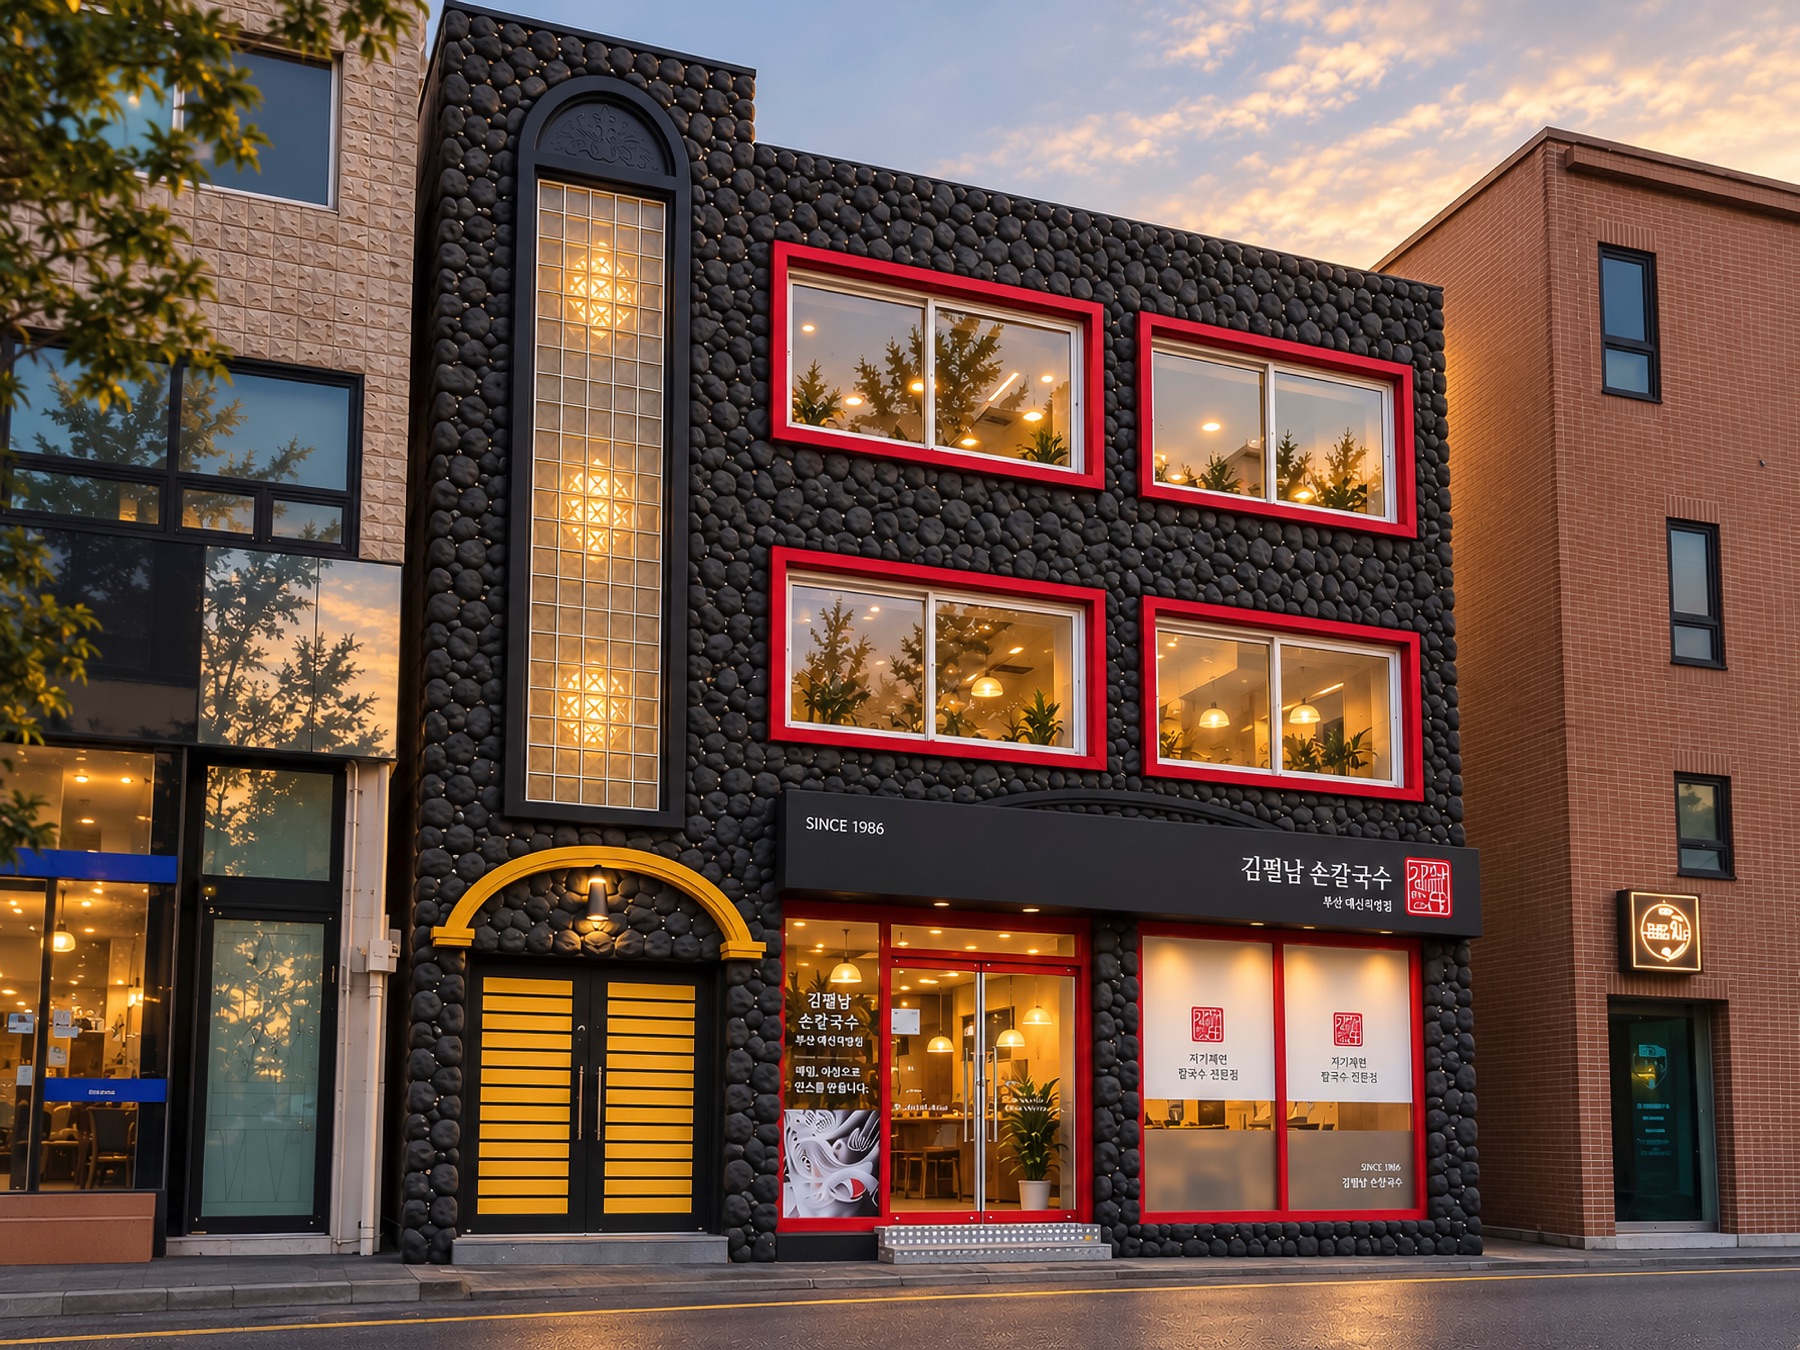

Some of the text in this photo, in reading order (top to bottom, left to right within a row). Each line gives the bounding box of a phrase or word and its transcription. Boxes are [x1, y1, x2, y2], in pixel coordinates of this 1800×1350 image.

[805, 816, 885, 835] SINCE 1986
[1240, 855, 1304, 885] 김펄남
[1309, 860, 1392, 890] 손칼국수
[1322, 896, 1343, 909] 부산
